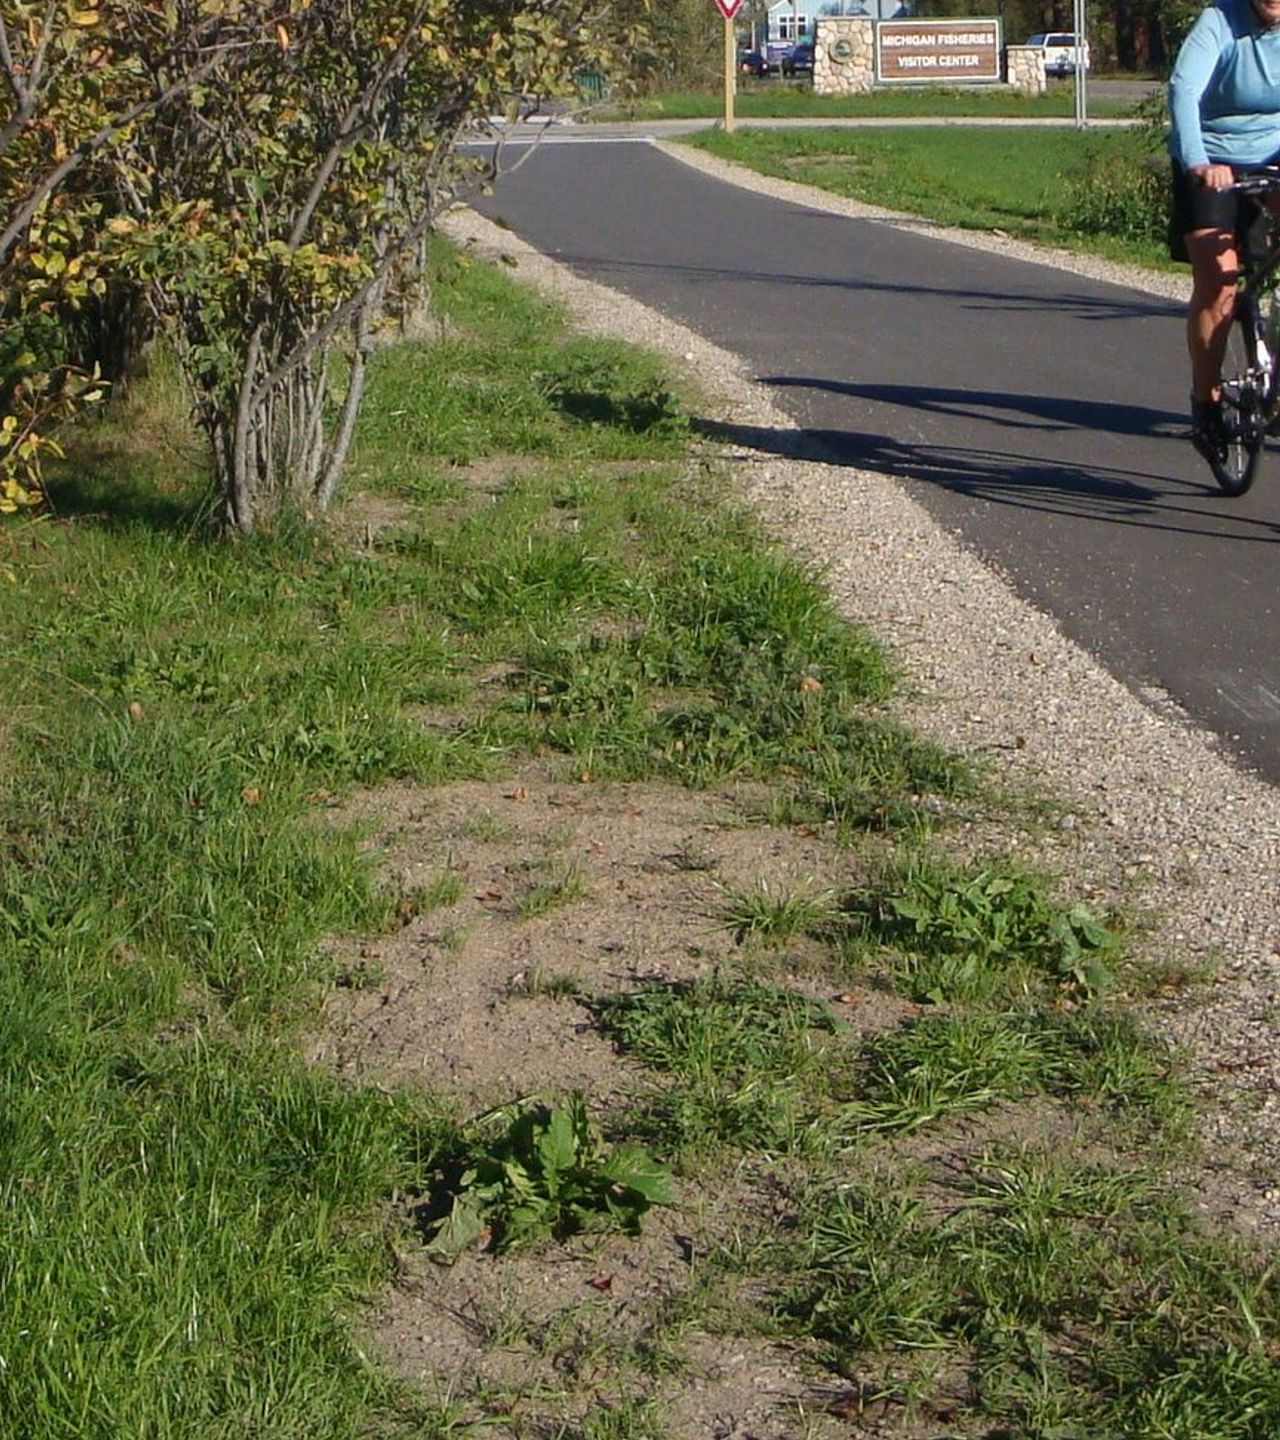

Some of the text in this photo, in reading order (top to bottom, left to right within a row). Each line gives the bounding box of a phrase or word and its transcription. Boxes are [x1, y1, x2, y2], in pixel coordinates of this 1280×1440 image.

[882, 33, 994, 46] MICHIGAN FISHERIES
[898, 54, 979, 67] VISITOR CENTER
